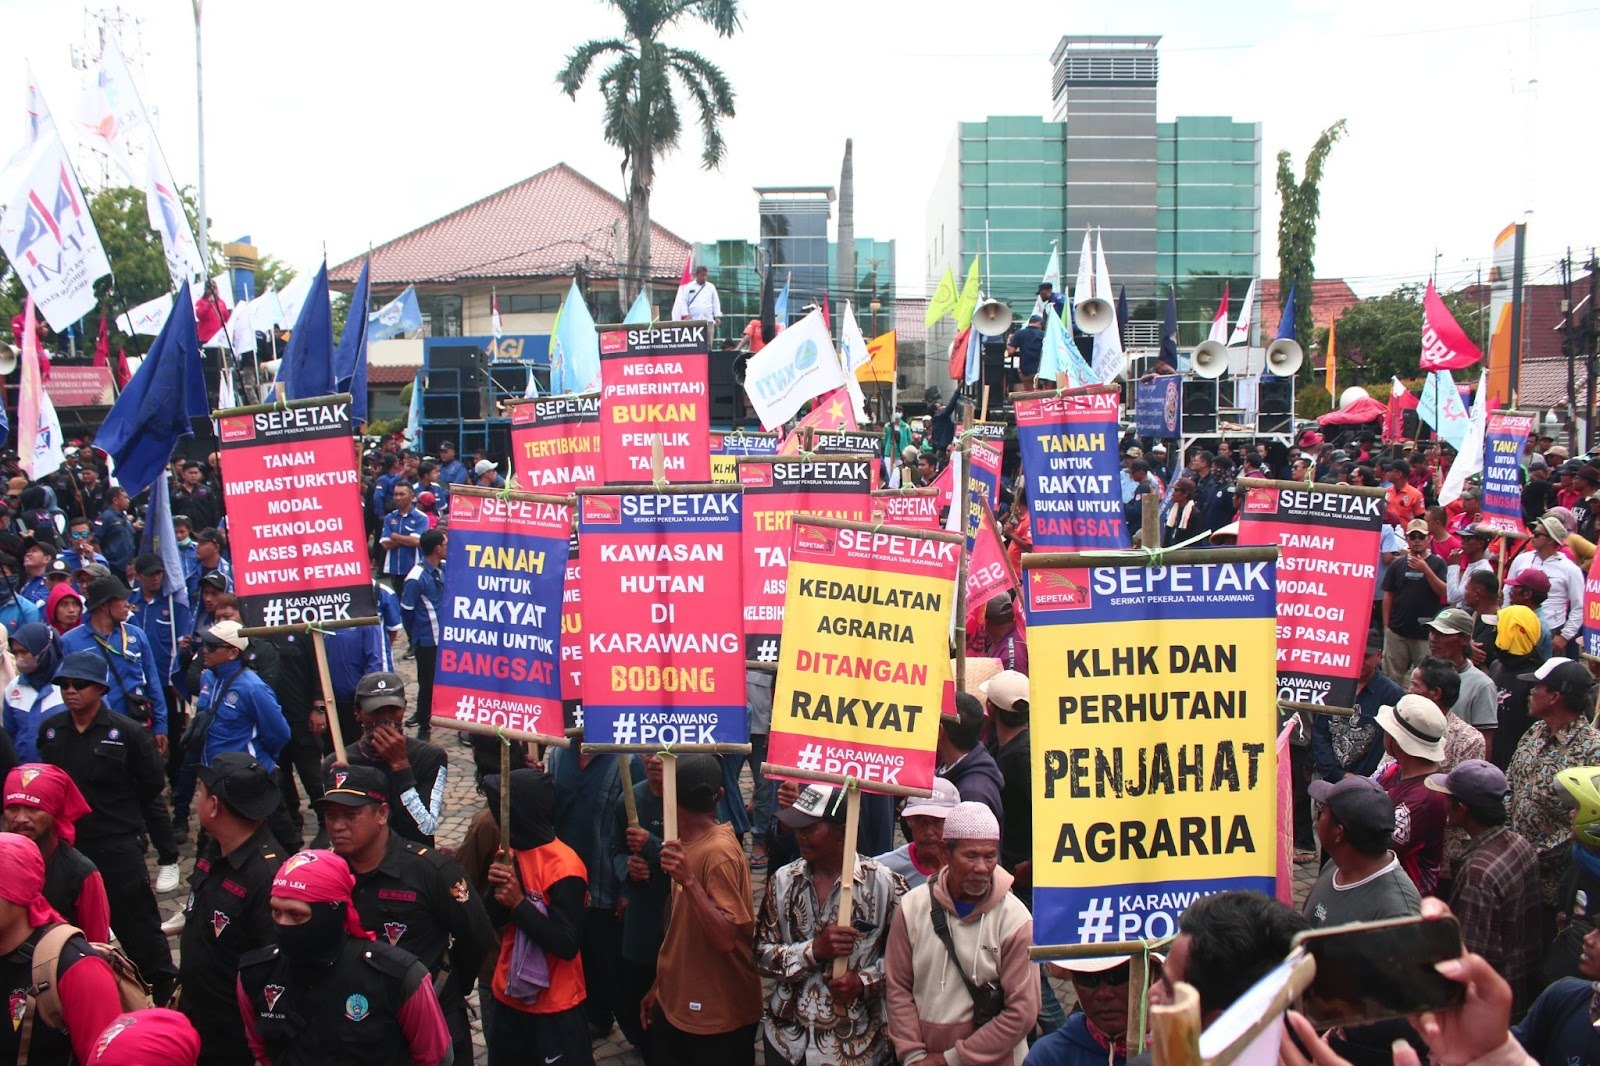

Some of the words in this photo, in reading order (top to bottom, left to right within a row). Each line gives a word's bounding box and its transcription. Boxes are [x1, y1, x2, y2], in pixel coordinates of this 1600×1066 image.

[628, 327, 704, 345] SEPETAK
[624, 363, 683, 376] NEGARA
[604, 382, 705, 399] (PEMERINTAH)
[255, 403, 349, 432] SEPETAK
[612, 404, 696, 424] BUKAN
[524, 436, 590, 458] TERTIBKAN
[723, 436, 777, 448] SEPETAK
[819, 435, 879, 449] SEPETAK
[1037, 433, 1105, 453] TANAH
[263, 451, 315, 468] TANAH
[971, 443, 999, 467] SEPETAK
[1050, 457, 1093, 470] UNTUK
[528, 465, 595, 487] TANAH
[773, 462, 868, 480] SEPETAK
[225, 470, 358, 496] IMPRASTURKTUR
[1038, 475, 1112, 494] RAKYAT
[268, 497, 322, 514] MODAL
[482, 498, 569, 522] SEPETAK
[623, 493, 739, 516] SEPETAK
[888, 497, 937, 515] SEPETAK
[1034, 500, 1073, 512] BUKAN
[1078, 500, 1120, 512] UNTUK
[1280, 489, 1381, 516] SEPETAK
[253, 518, 342, 539] TEKNOLOGI
[1036, 517, 1121, 538] BANGSAT
[248, 544, 297, 562] AKSES
[302, 540, 354, 557] PASAR
[799, 541, 825, 549] SEPETAK
[838, 530, 954, 562] SEPETAK
[1279, 533, 1334, 551] TANAH
[465, 544, 545, 574] TANAH
[600, 544, 723, 562] KAWASAN
[872, 554, 898, 562] PEKERJA
[911, 559, 943, 567] KARAWANG
[245, 566, 300, 586] UNTUK
[304, 562, 361, 580] PETANI
[620, 575, 704, 593] HUTAN
[1094, 561, 1270, 595] SEPETAK
[478, 575, 531, 595] UNTUK
[799, 578, 941, 612] KEDAULATAN
[1276, 579, 1328, 596] MODAL
[1035, 594, 1075, 604] SEPETAK
[1110, 596, 1146, 605] SERIKAT
[1148, 595, 1185, 605] PEKERJA
[1186, 595, 1205, 603] TANI
[1207, 594, 1255, 603] KARAWANG
[286, 603, 351, 626] POEK
[453, 596, 546, 628] RAKYAT
[651, 603, 674, 624] DI
[817, 615, 914, 644] AGRARIA
[1296, 626, 1350, 645] PASAR
[443, 626, 498, 646] BUKAN
[503, 633, 553, 655] UNTUK
[590, 633, 739, 654] KARAWANG
[441, 649, 553, 685] BANGSAT
[796, 649, 928, 686] DITANGAN
[1067, 646, 1160, 678] KLHK
[1170, 644, 1237, 674] DAN
[1291, 648, 1350, 668] PETANI
[611, 665, 715, 693] BODONG
[791, 690, 923, 733] RAKYAT
[1059, 690, 1246, 725] PERHUTANI
[640, 725, 717, 744] POEK
[1044, 740, 1264, 800] PENJAHAT
[1052, 815, 1255, 863] AGRARIA
[290, 881, 306, 890] LEM
